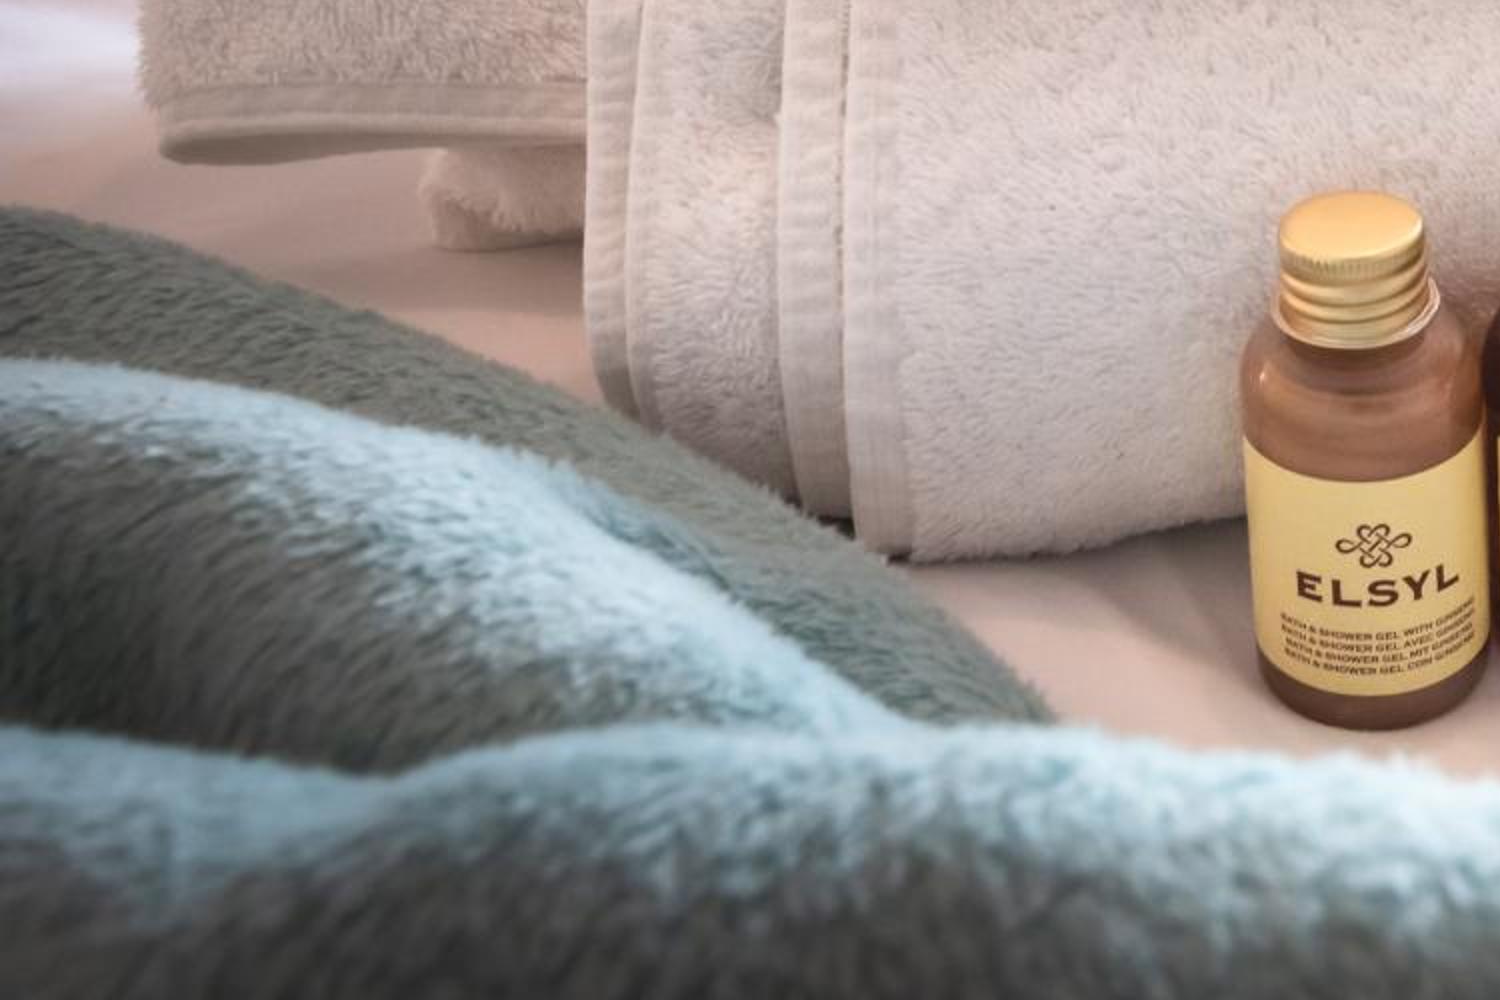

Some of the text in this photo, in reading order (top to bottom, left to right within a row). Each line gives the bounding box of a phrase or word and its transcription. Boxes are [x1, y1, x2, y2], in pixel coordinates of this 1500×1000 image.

[1297, 564, 1460, 609] ELSYL
[1319, 627, 1373, 641] SHOWER
[1375, 631, 1400, 641] GEL
[1403, 621, 1433, 637] WITH
[1319, 639, 1373, 653] SHOWER
[1375, 642, 1401, 653] GEL
[1403, 632, 1434, 649] AVEC
[1324, 650, 1380, 665] SHOWER
[1382, 653, 1408, 663] GEL
[1410, 645, 1430, 658] MIT
[1323, 662, 1378, 677] SHOWER
[1379, 665, 1405, 676] GEL
